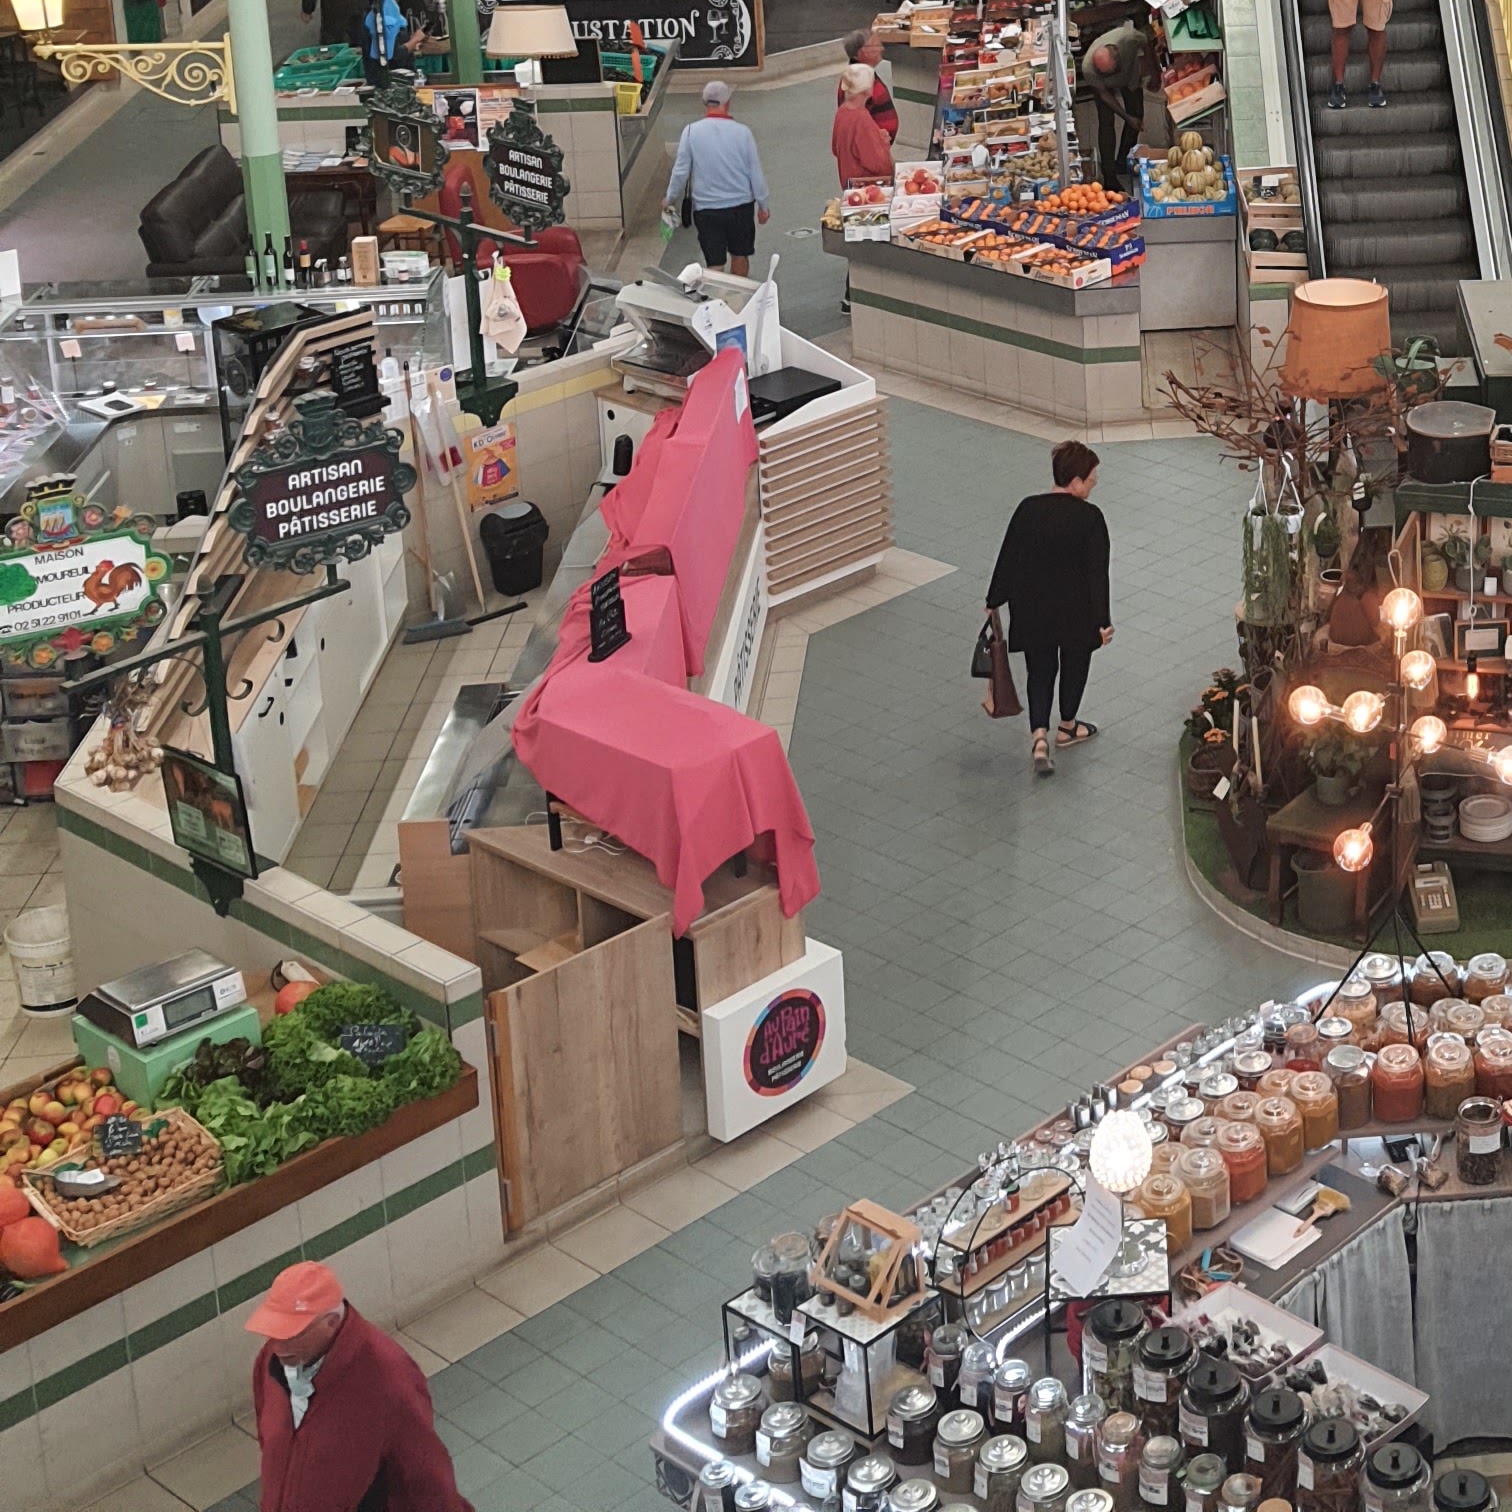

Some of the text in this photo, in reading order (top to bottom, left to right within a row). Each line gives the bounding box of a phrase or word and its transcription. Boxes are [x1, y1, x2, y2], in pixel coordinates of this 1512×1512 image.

[508, 149, 543, 170] ARTISAN
[498, 162, 553, 190] BOULANGERIE
[503, 179, 549, 205] PÂTISSERIE
[287, 459, 363, 491] ARTISAN
[265, 476, 386, 519] BOULANGERIE
[278, 500, 378, 539] PÂTISSERIE
[34, 546, 85, 566] MAISON
[7, 591, 86, 615] PRODUCTEUR
